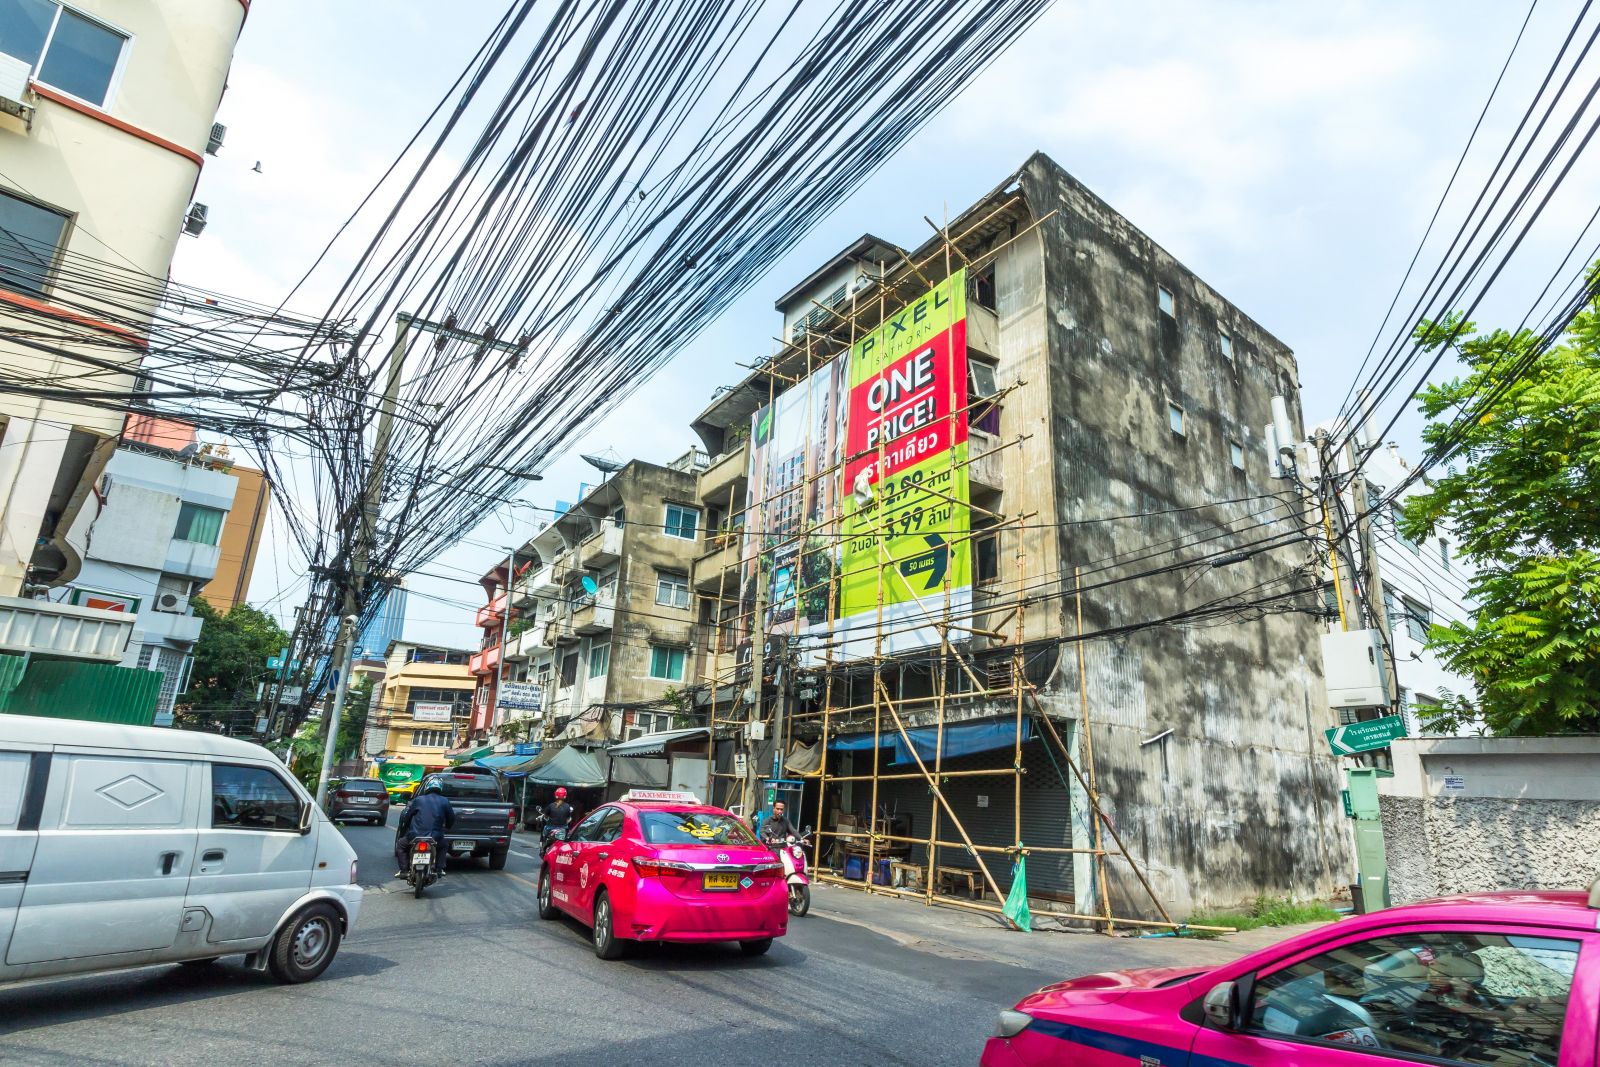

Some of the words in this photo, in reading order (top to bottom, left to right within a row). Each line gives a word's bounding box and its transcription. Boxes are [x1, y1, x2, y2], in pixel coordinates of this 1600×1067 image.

[876, 323, 931, 365] SATHORN
[867, 348, 936, 412] ONE
[867, 396, 936, 450] PRICE!
[866, 433, 938, 478] ราคาเดียว
[885, 470, 923, 506] 2.99
[884, 507, 923, 541] 3.99
[928, 507, 951, 526] ล้าน
[908, 561, 917, 572] 50
[720, 875, 737, 883] 5923
